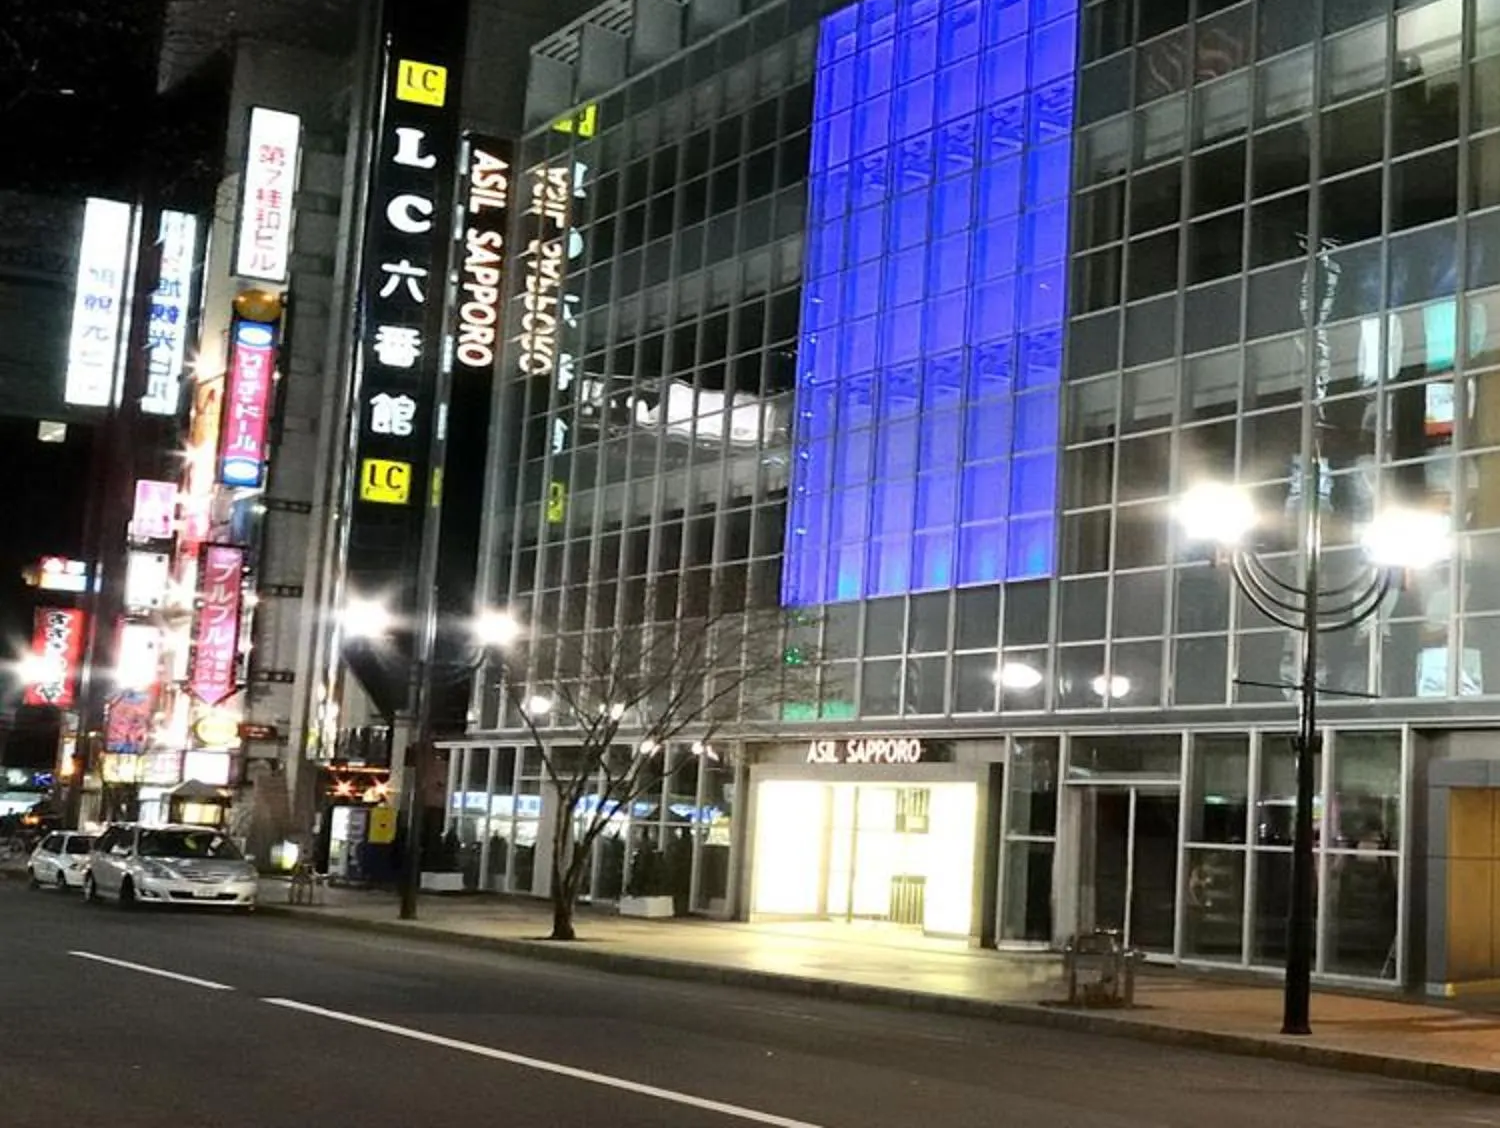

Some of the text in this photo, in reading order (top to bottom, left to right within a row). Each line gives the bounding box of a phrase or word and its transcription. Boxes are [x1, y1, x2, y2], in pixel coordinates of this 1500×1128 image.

[368, 127, 437, 437] LC六番館
[456, 149, 509, 367] ASIL SAPPORO
[806, 738, 921, 764] ASIL SAPPORO
